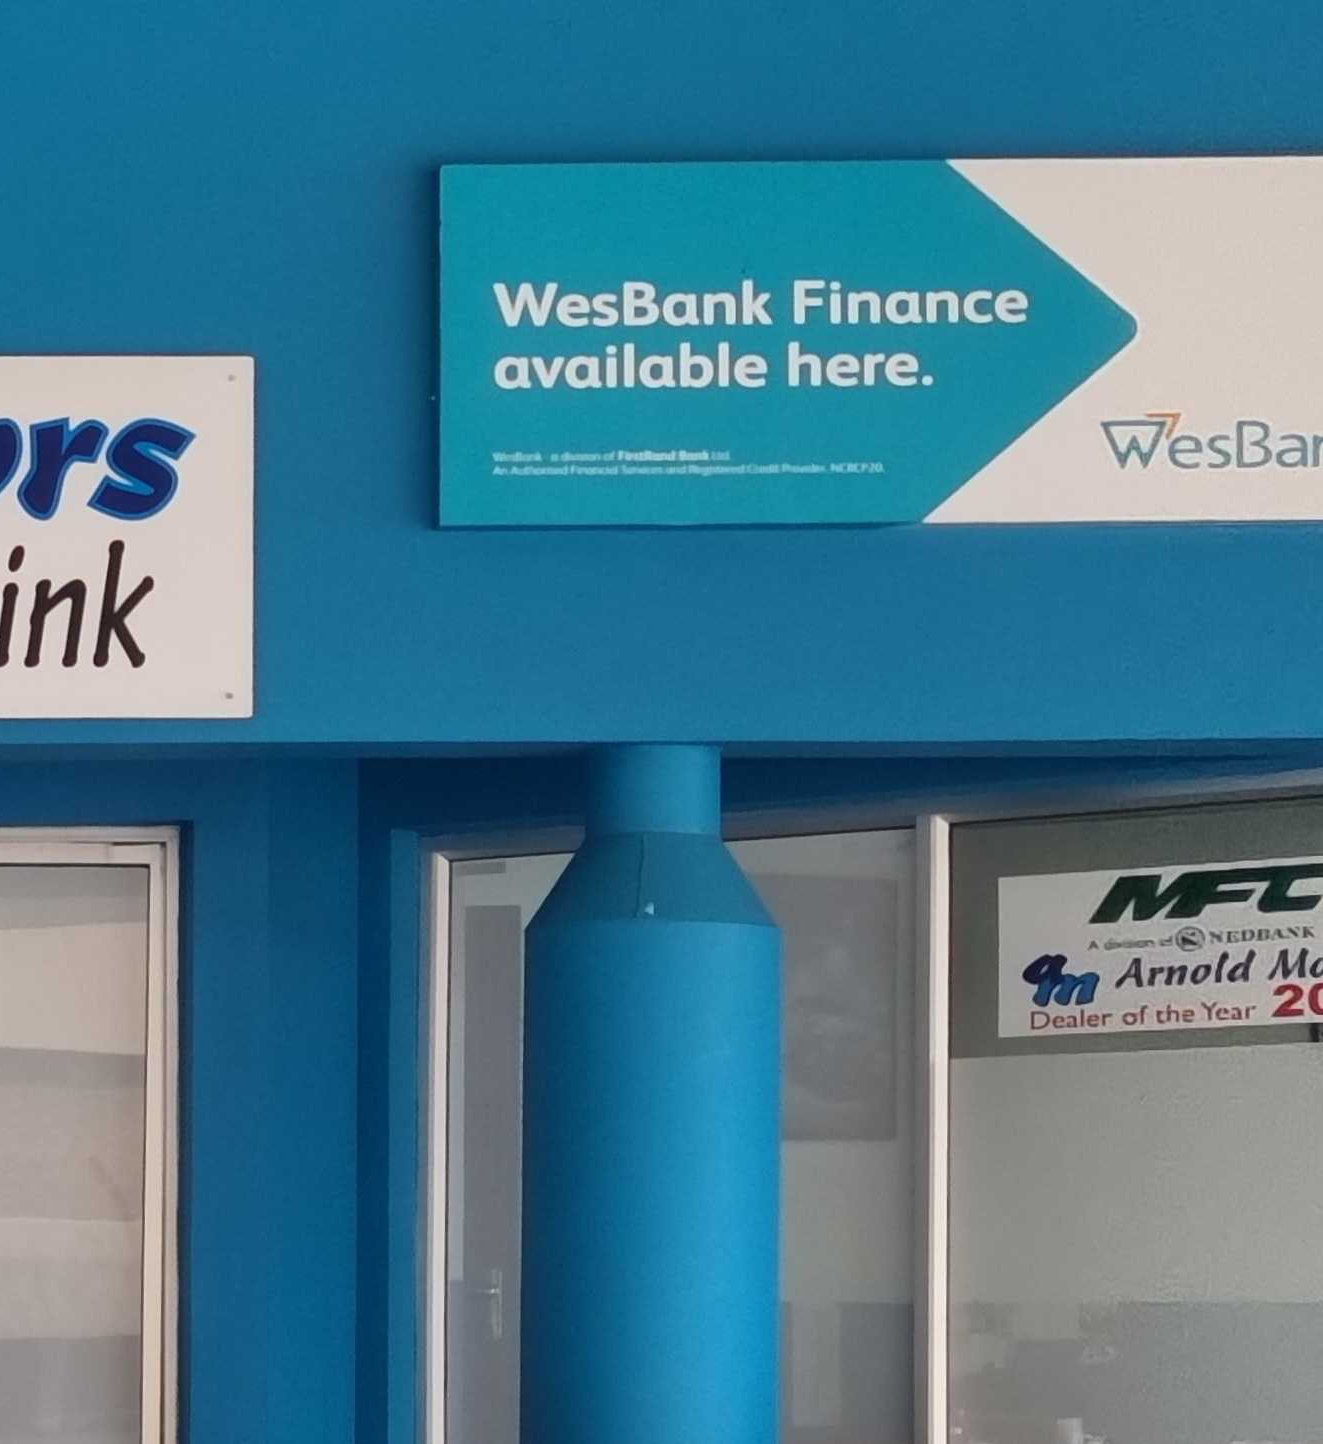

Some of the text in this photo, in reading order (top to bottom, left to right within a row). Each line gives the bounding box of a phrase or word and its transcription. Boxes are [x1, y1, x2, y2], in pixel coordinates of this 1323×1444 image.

[493, 279, 1029, 328] WesBank Finance
[494, 342, 934, 390] available here.
[1088, 863, 1323, 924] MFC
[1209, 926, 1315, 944] NEDBANK
[1115, 949, 1256, 989] Arnold
[1030, 1008, 1113, 1030] Dealer
[1121, 1005, 1148, 1026] of
[1156, 1004, 1195, 1024] the
[1201, 1002, 1257, 1022] Year
